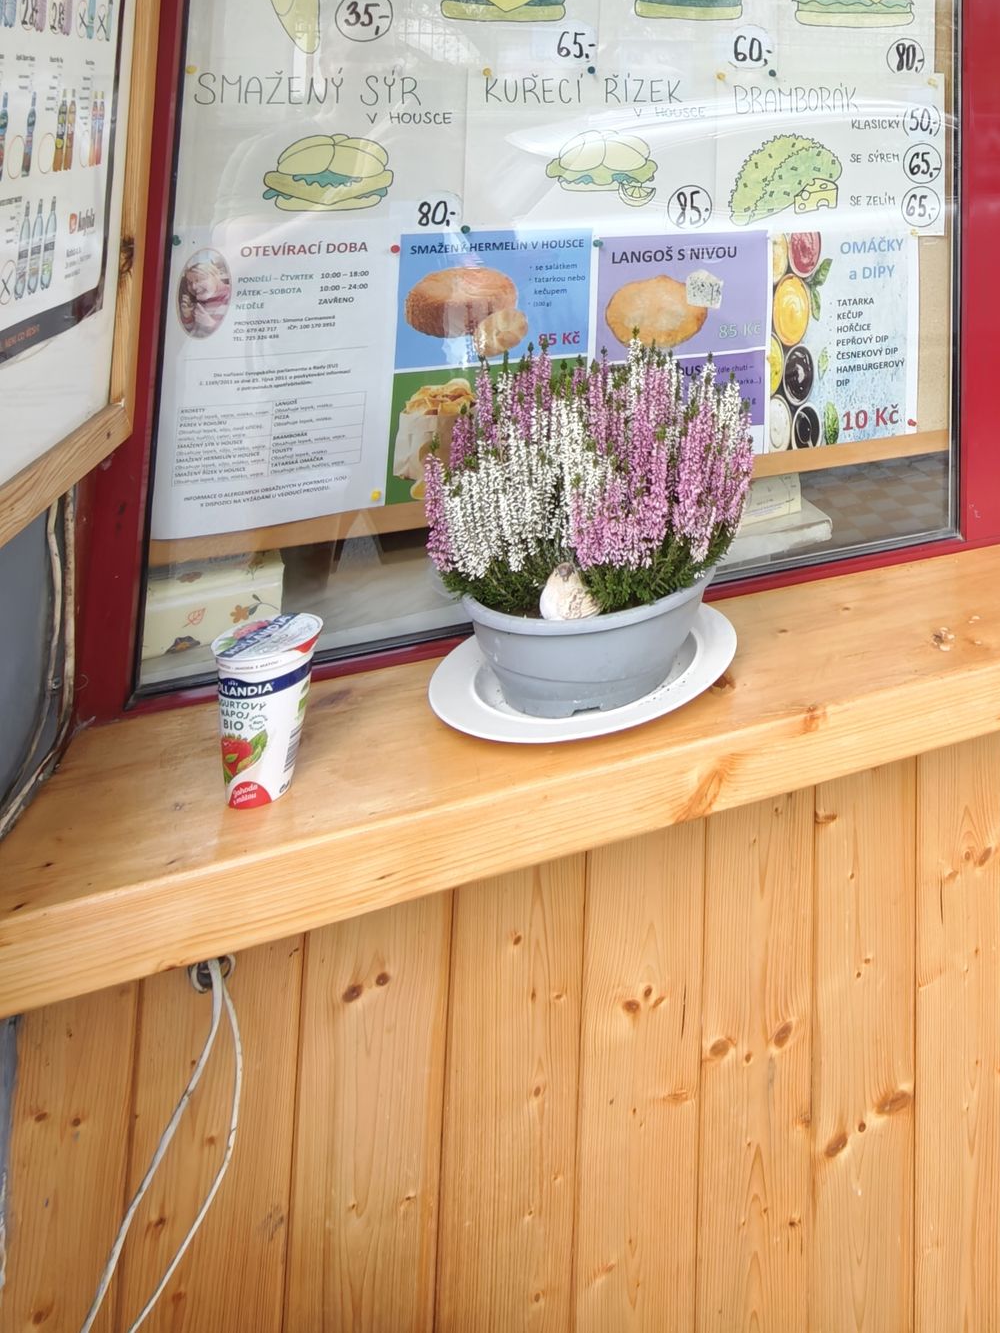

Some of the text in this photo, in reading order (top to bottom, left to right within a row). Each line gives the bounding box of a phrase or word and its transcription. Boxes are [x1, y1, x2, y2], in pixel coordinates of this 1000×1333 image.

[344, 1, 390, 36] 35,-
[194, 67, 421, 106] SMAŽENÝ SÝR
[485, 72, 683, 104] KUŘECÍ ŘÍZEK
[733, 82, 862, 115] BRAMBORÁK
[367, 111, 452, 125] V HOUSCE
[633, 106, 706, 118] V HOUSCE
[851, 115, 900, 130] KLASICKÝ
[850, 149, 900, 163] SE SÝREM
[850, 192, 896, 207] SE ZELÍM
[240, 241, 368, 258] OTEVÍRACÍ DOBA
[531, 240, 538, 250] V
[541, 239, 585, 249] HOUSCE
[840, 238, 904, 255] OMÁČKY
[611, 245, 738, 265] LANGOŠ S NIVOU
[534, 273, 586, 284] tatarkou nebo
[849, 270, 857, 280] a
[236, 289, 261, 297] PÁTEK
[270, 287, 302, 295] SOBOTA
[534, 287, 568, 296] kečupem
[318, 296, 354, 305] ZAVŘENO
[837, 297, 875, 308] TATARKA
[837, 310, 864, 321] KEČUP
[719, 324, 738, 339] 85
[836, 323, 872, 334] HOŘČICE
[562, 331, 580, 345] Kč
[836, 334, 889, 347] PEPŘOVÝ DIP
[836, 347, 898, 360] ČESNEKOVÝ DIP
[836, 358, 905, 374] HAMBURGEROVÝ
[836, 378, 850, 388] DIP
[842, 403, 899, 431] 10 Kč
[223, 719, 244, 731] BIO
